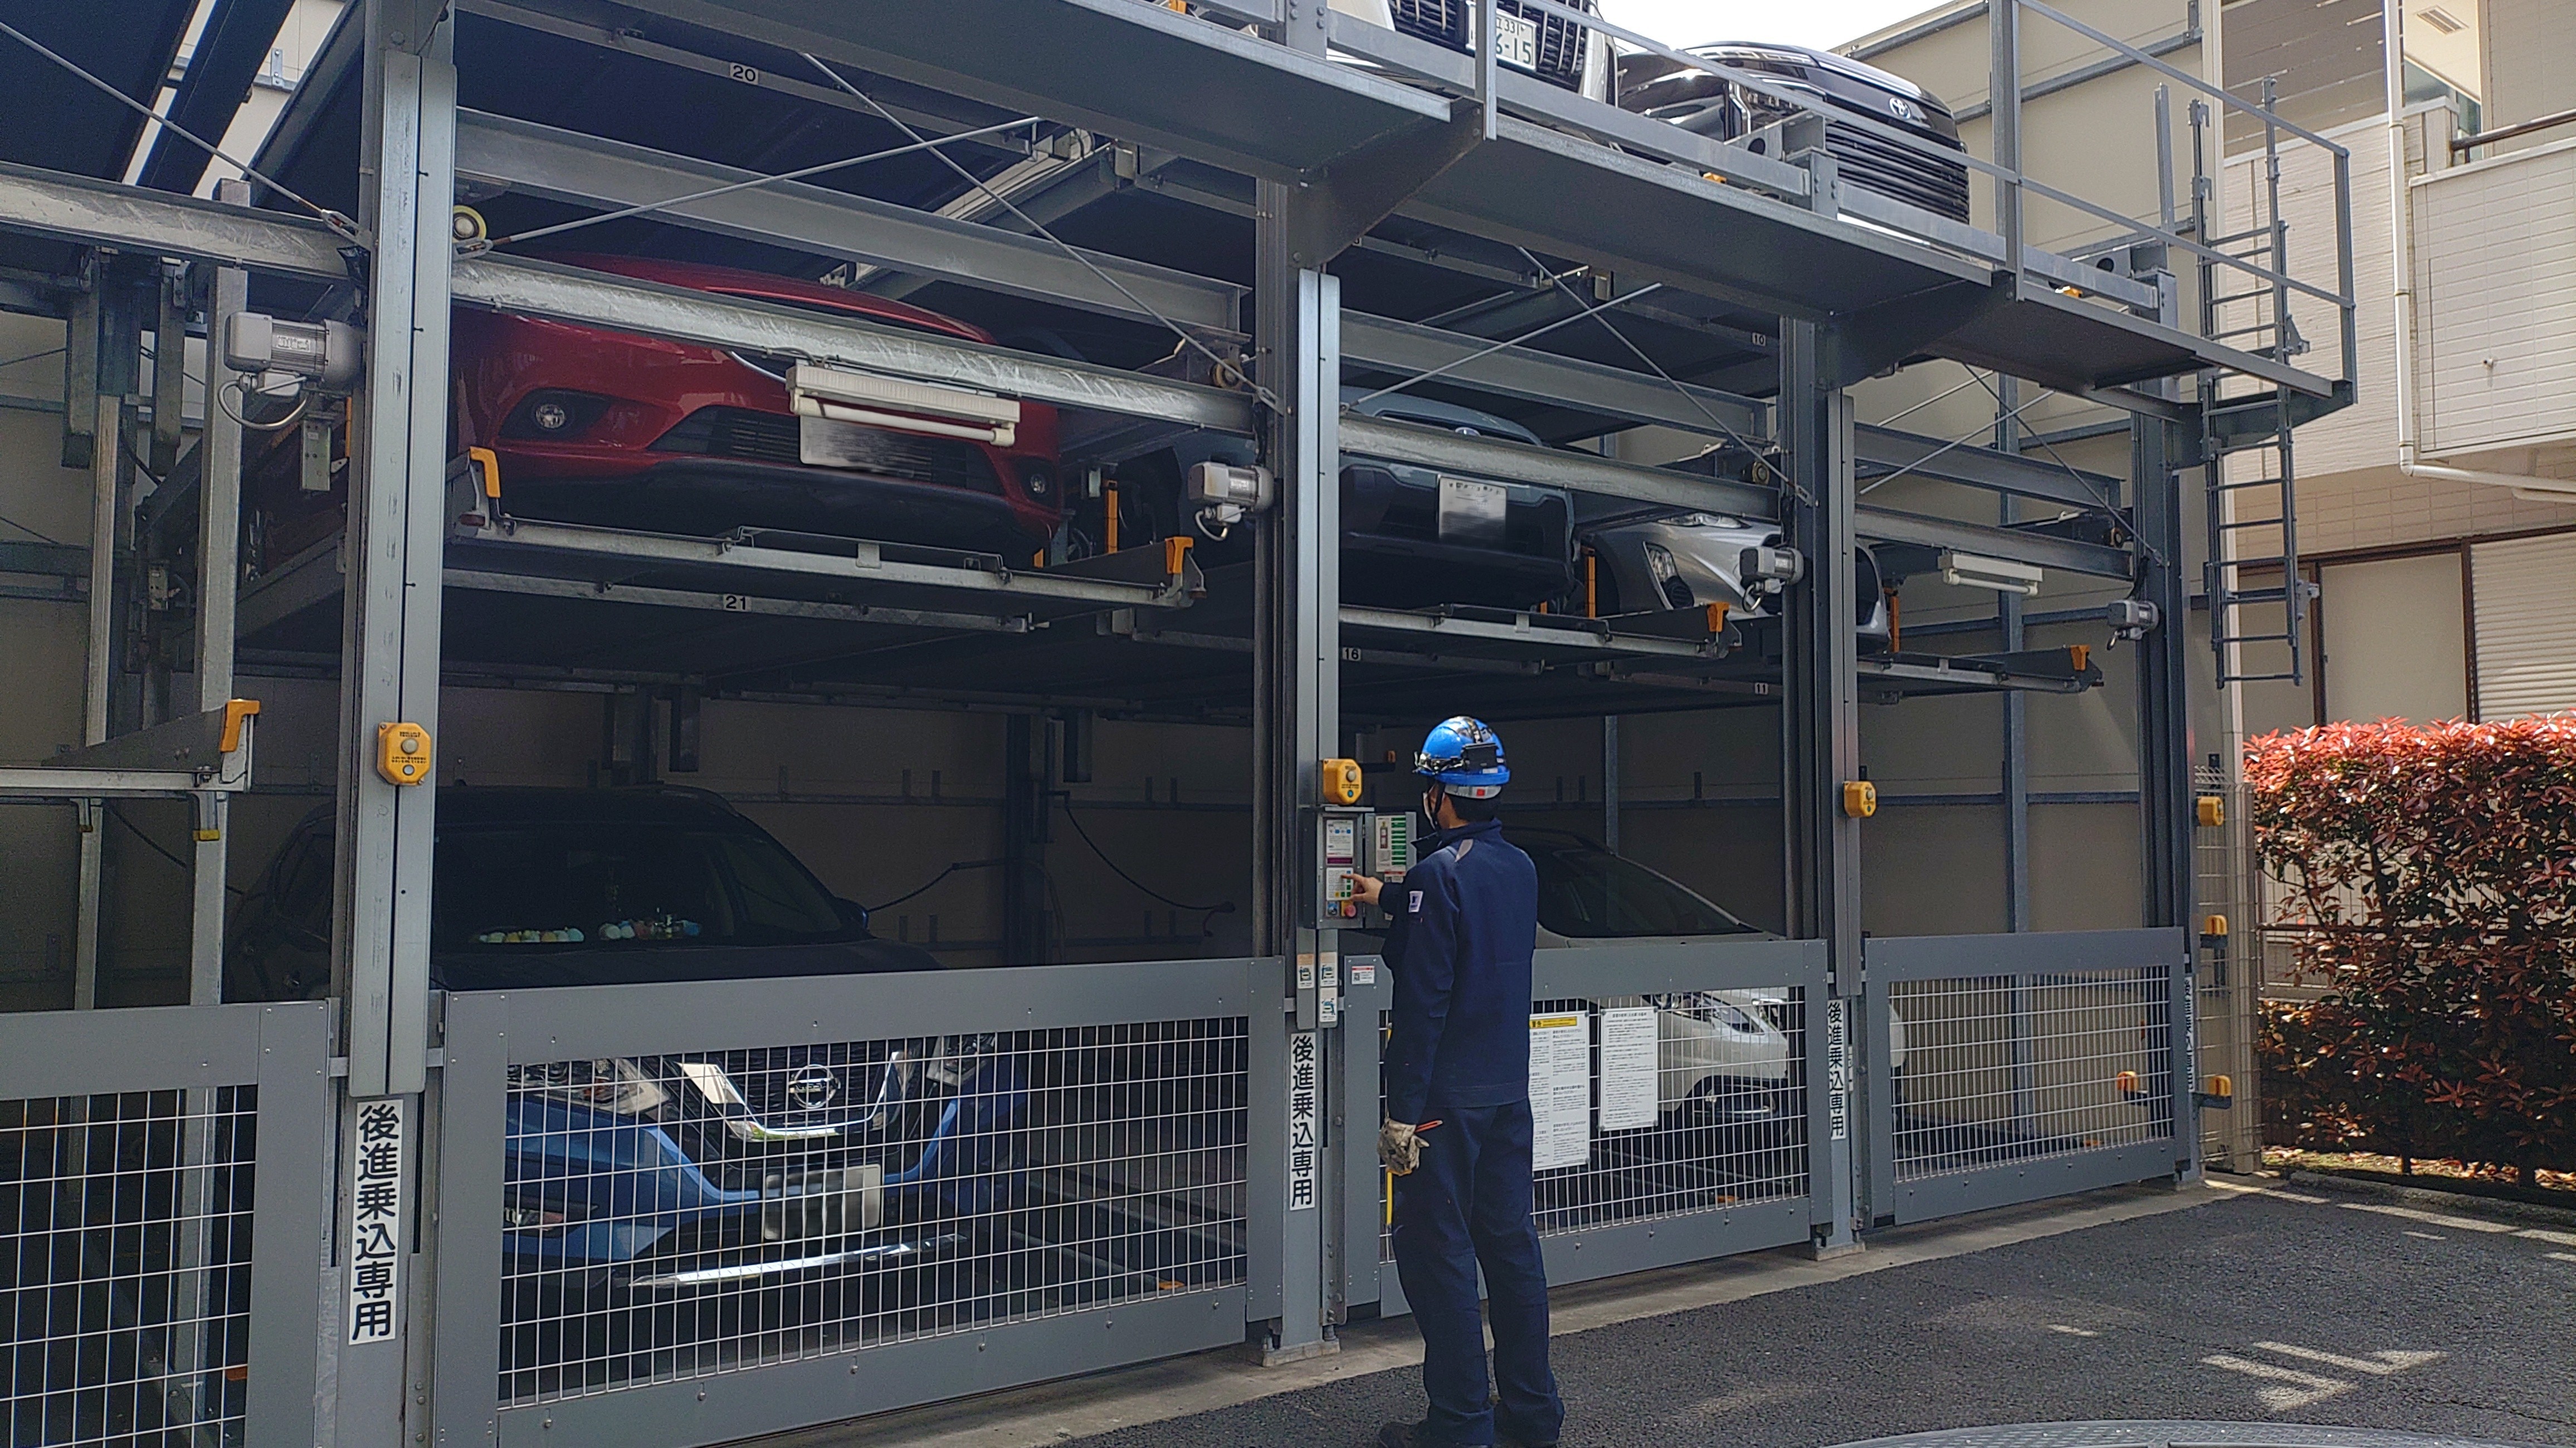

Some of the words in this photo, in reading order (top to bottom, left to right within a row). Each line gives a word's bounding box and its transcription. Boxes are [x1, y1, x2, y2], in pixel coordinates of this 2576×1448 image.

[1504, 19, 1519, 35] 331
[733, 65, 756, 81] 20
[1755, 335, 1764, 345] 10
[726, 595, 745, 610] 21
[1345, 648, 1359, 660] 16
[1757, 684, 1765, 693] 11
[1828, 1001, 1843, 1136] 後進乗込専用
[1291, 1035, 1314, 1207] 後進乗込専用
[352, 1103, 399, 1341] 後進乗込専用
